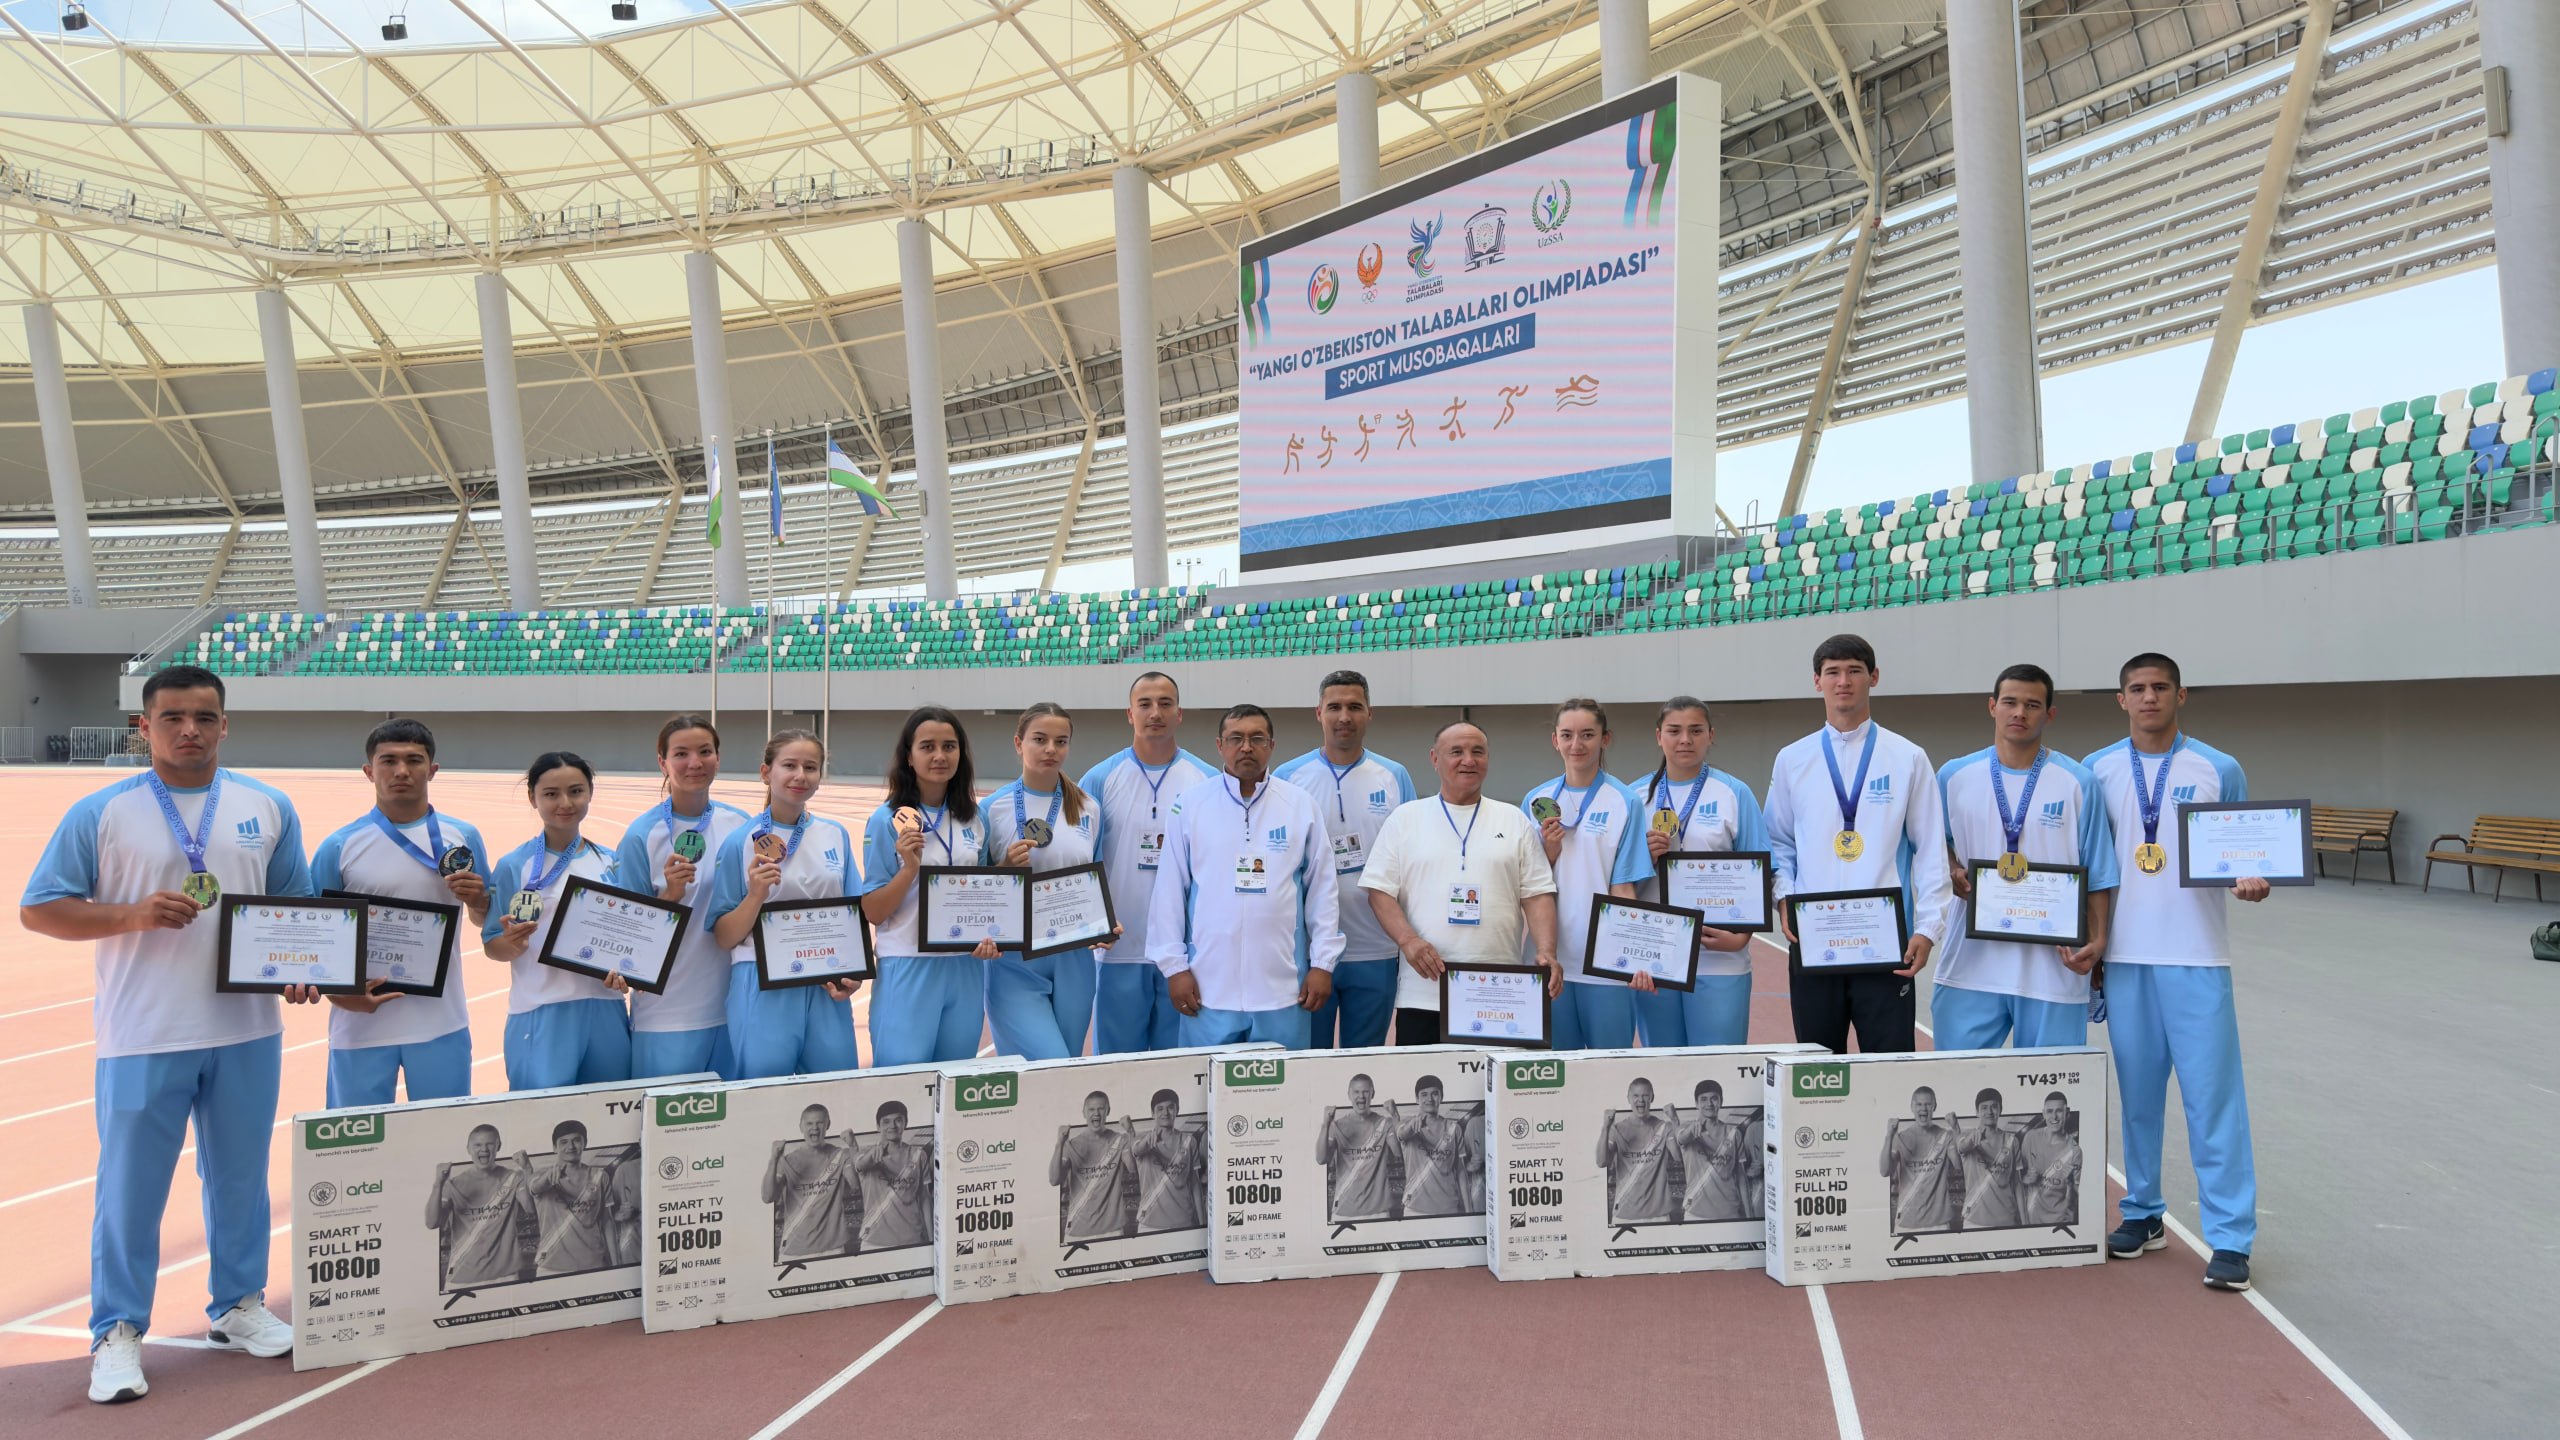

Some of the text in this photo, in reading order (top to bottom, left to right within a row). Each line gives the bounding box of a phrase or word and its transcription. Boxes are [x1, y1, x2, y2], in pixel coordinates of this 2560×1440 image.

[1538, 232, 1564, 249] UzSSA
[1405, 286, 1444, 303] OLIMPIADASI
[1407, 280, 1443, 296] TALABALARI
[1301, 324, 1397, 369] O'ZBEKISTON
[1401, 293, 1508, 339] TALABALARI
[1339, 324, 1520, 390] SPORT MUSOBAQALARI
[1696, 898, 1735, 906] DIPLOM
[956, 915, 995, 924] DIPLOM
[1049, 913, 1083, 927] DIPLOM
[2006, 908, 2047, 919] DIPLOM
[590, 936, 634, 956] DIPLOM
[1828, 937, 1869, 947] DIPLOM
[268, 952, 319, 963] DIPLOM
[368, 950, 404, 963] IPLOM
[795, 947, 835, 958] DIPLOM
[1622, 946, 1661, 960] DIPLOM
[1477, 1010, 1514, 1020] DIPLOM
[1233, 1059, 1277, 1078] artel
[1514, 1061, 1557, 1081] artel
[1800, 1070, 1843, 1089] artel
[963, 1080, 1010, 1102] artel
[665, 1093, 717, 1117] artel
[316, 1115, 375, 1139] artel
[1255, 1117, 1283, 1130] artel
[1536, 1120, 1564, 1132] artel
[1821, 1129, 1848, 1141] artel
[986, 1139, 1015, 1154] artel
[692, 1155, 724, 1171] artel
[1227, 1155, 1283, 1167] SMART TV
[1509, 1158, 1563, 1169] SMART TV
[1227, 1168, 1282, 1182] FULL HD
[1509, 1171, 1563, 1184] FULL HD
[1795, 1167, 1848, 1178] SMART TV
[346, 1180, 383, 1196] artel
[956, 1178, 1015, 1194] SMART TV
[1795, 1180, 1847, 1193] FULL HD
[956, 1193, 1014, 1210] FULL HD
[1226, 1184, 1281, 1205] 1080p
[1508, 1186, 1562, 1207] 1080p
[658, 1196, 723, 1212] SMART TV
[1794, 1195, 1847, 1216] 1080p
[658, 1210, 723, 1228] FULL HD
[955, 1210, 1013, 1234] 1080p
[1258, 1212, 1281, 1220] FRAME
[1540, 1215, 1562, 1223] FRAME
[309, 1222, 382, 1241] SMART TV
[1825, 1224, 1847, 1232] FRAME
[309, 1238, 381, 1258] FULL HD
[657, 1228, 721, 1253] 1080p
[989, 1238, 1013, 1248] FRAME
[307, 1256, 380, 1284] 1080p
[682, 1257, 721, 1269] NO FRAME
[335, 1287, 380, 1300] NO FRAME
